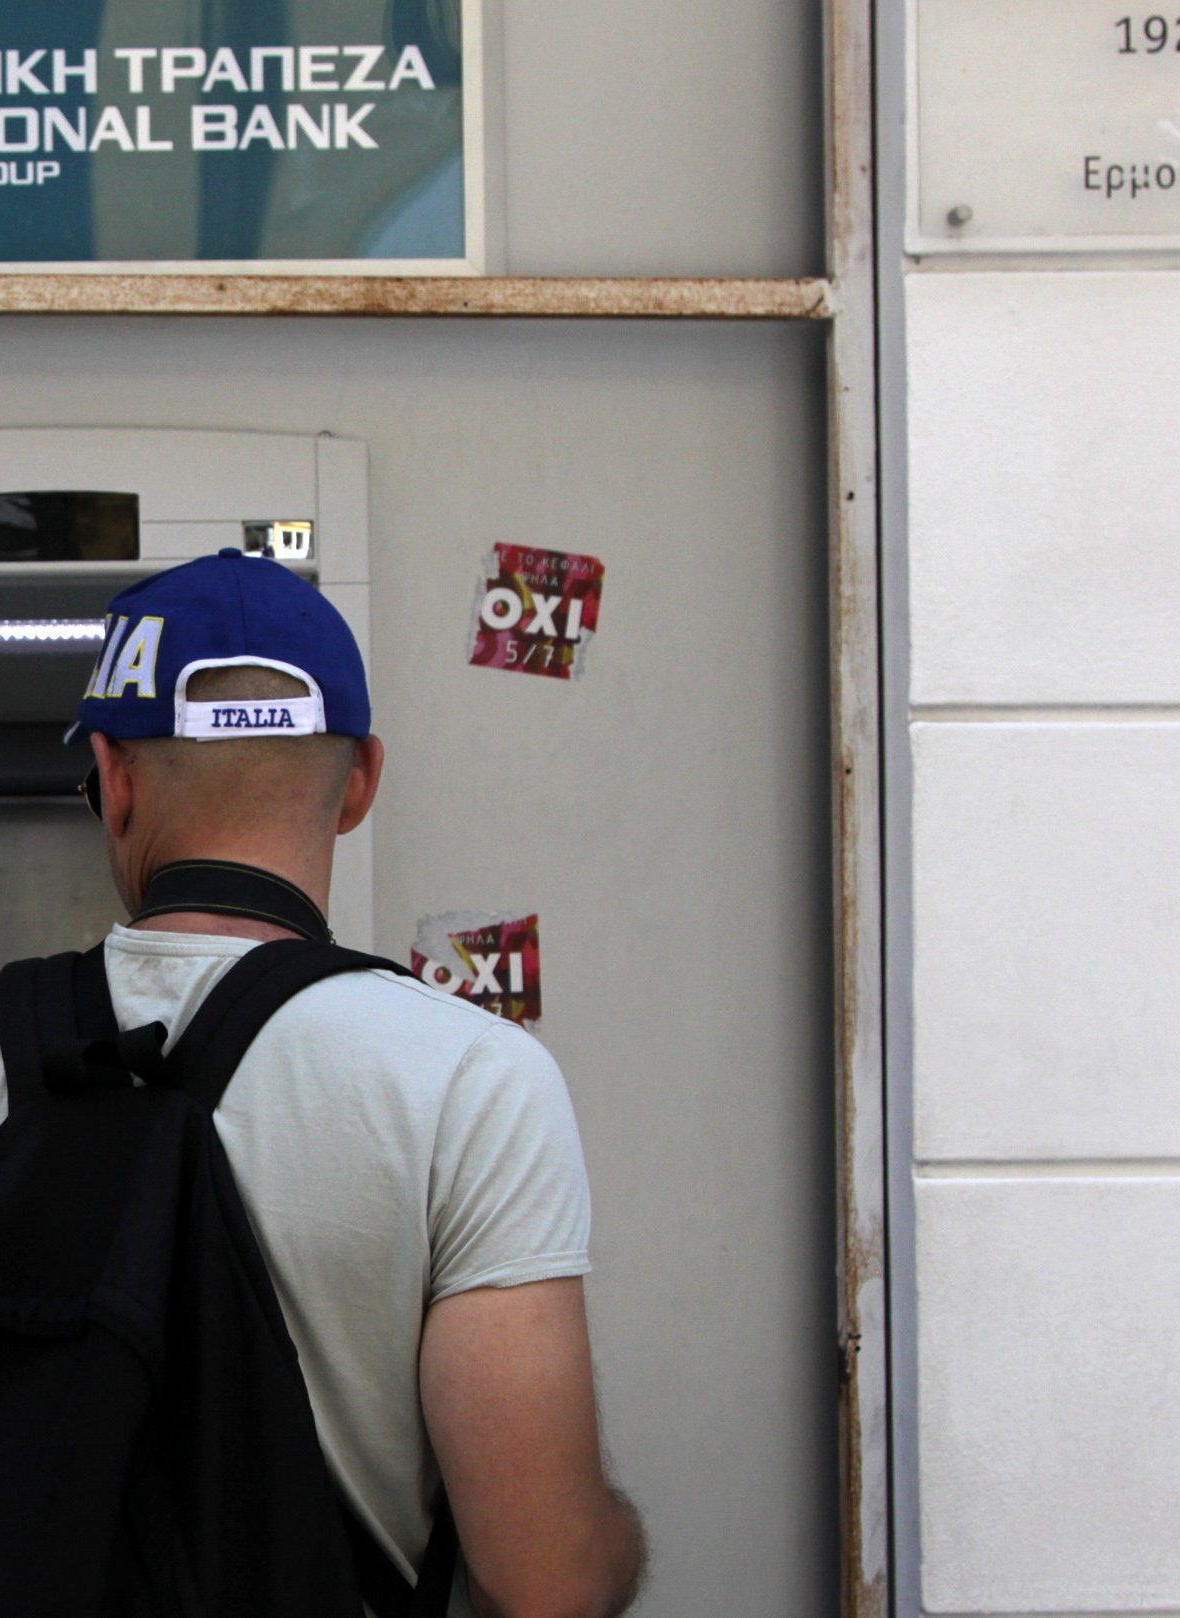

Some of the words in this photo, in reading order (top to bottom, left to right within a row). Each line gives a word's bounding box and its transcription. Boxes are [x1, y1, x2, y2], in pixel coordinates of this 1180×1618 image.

[1115, 16, 1180, 54] 19
[114, 44, 436, 94] ΤΡΑΠΕΖΑ
[191, 103, 380, 151] BANK
[1084, 156, 1176, 198] Ερμο
[481, 587, 583, 640] ΟΧΙ
[83, 613, 165, 699] IA
[504, 640, 555, 668] 5/7
[211, 708, 295, 728] ITALIA
[422, 952, 524, 995] ΟΧΙ
